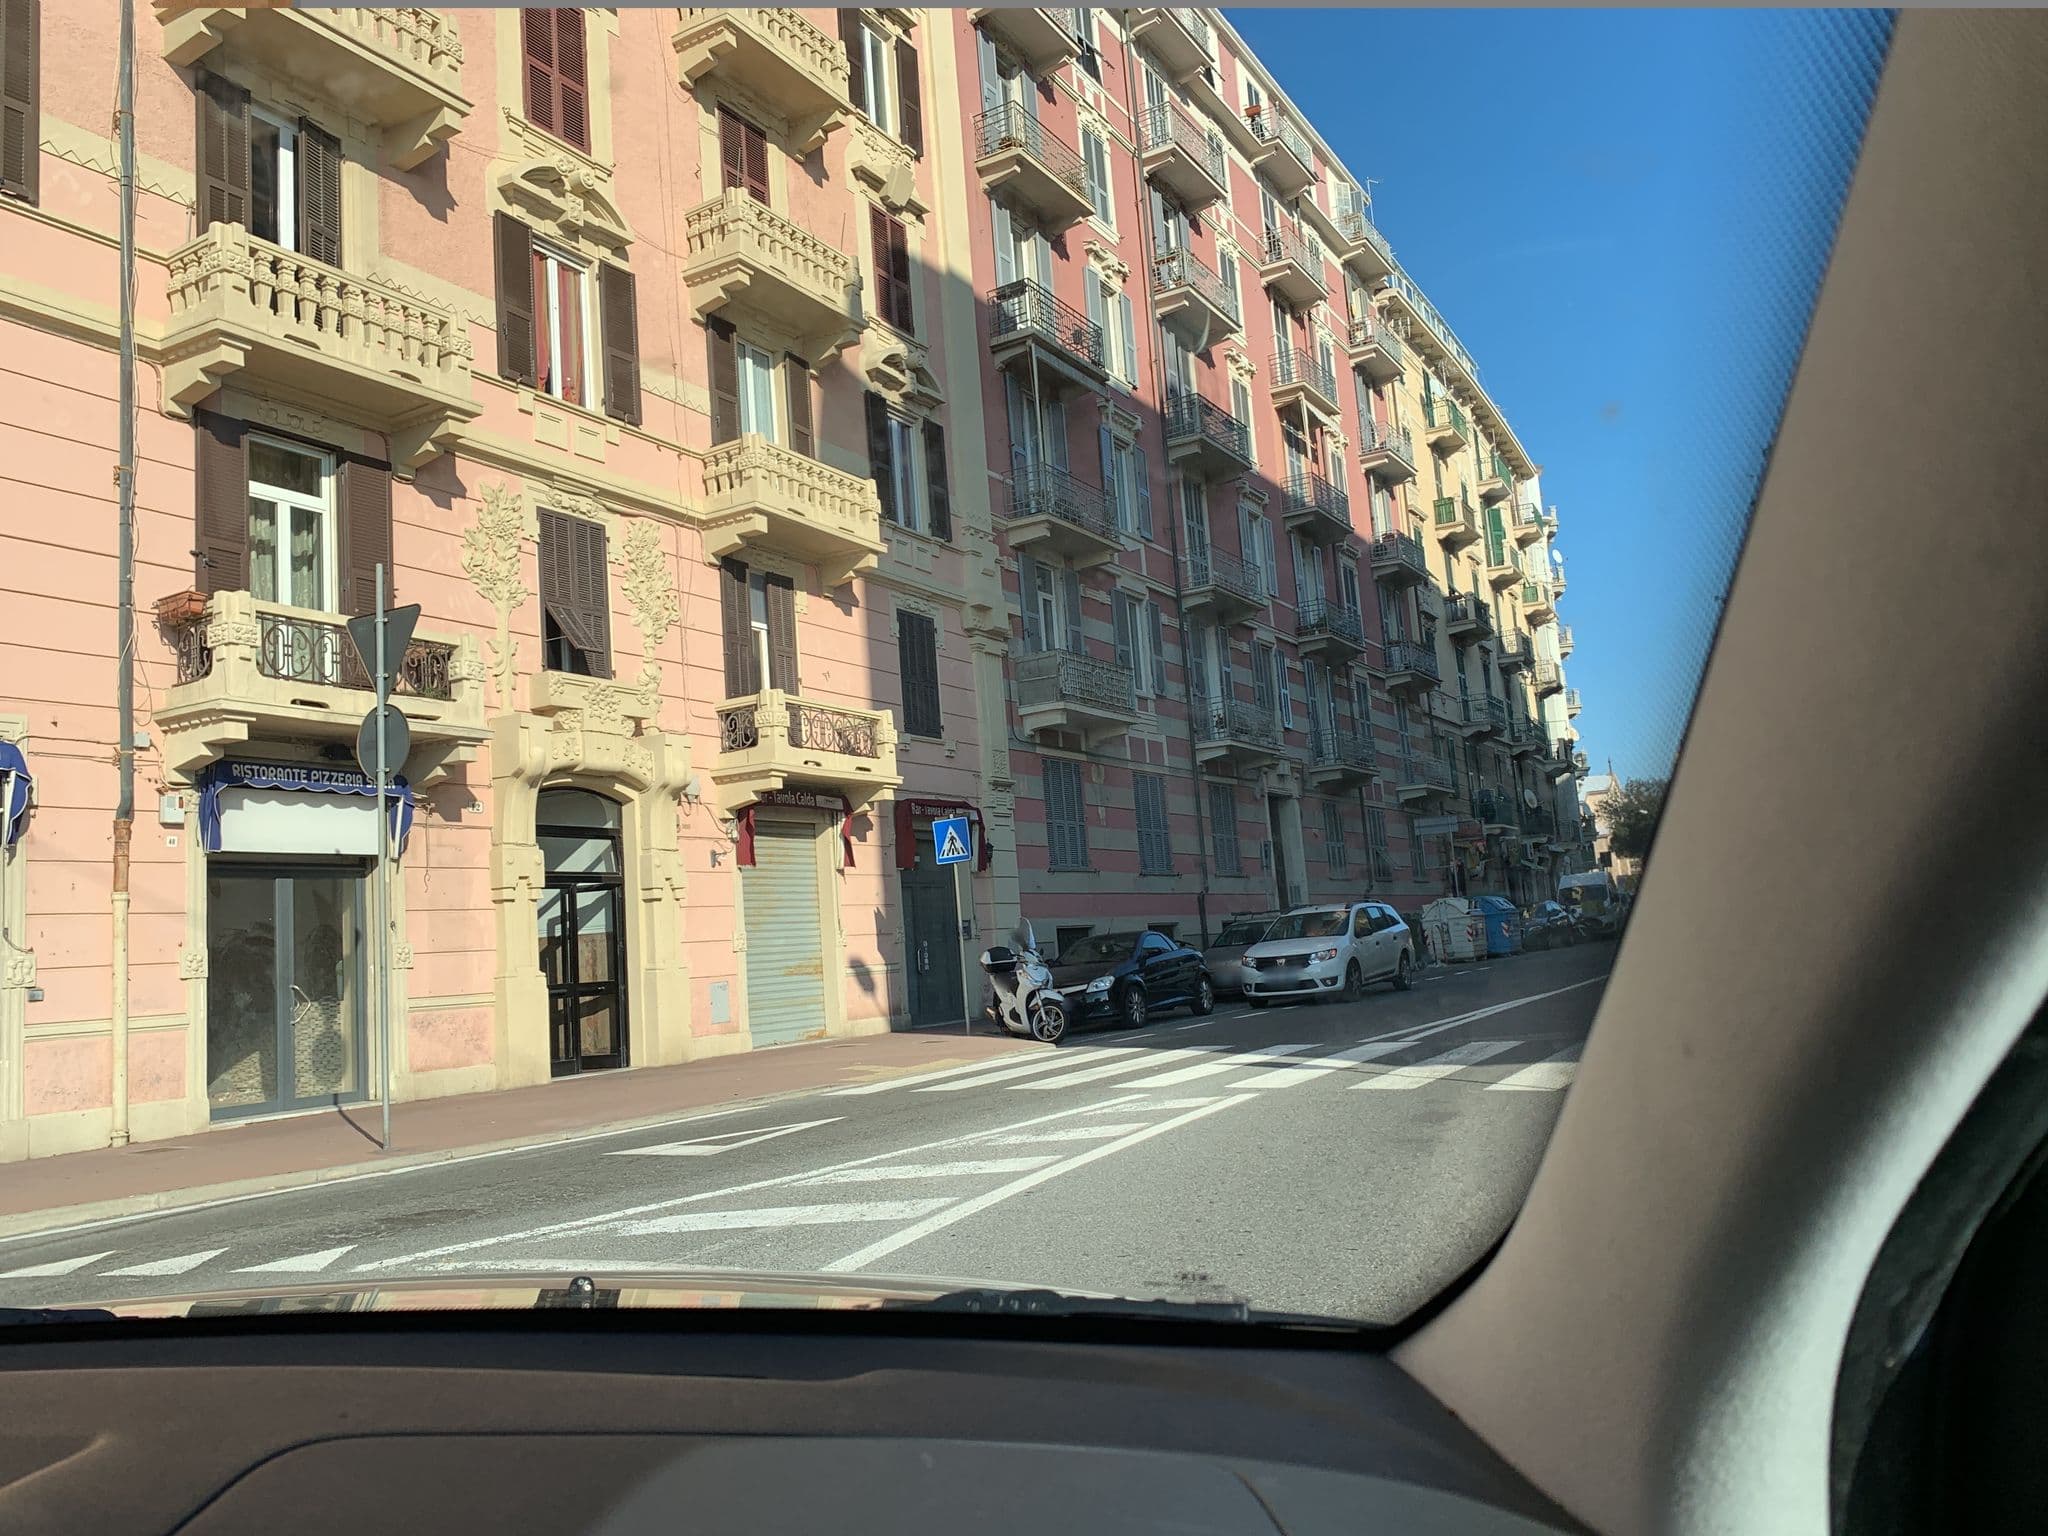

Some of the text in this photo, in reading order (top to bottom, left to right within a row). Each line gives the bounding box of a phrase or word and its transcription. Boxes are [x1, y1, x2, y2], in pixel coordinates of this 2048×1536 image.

[232, 764, 395, 789] RISTORANTE PIZZERIA SA
[774, 790, 795, 805] Tavola
[796, 792, 815, 806] Calda
